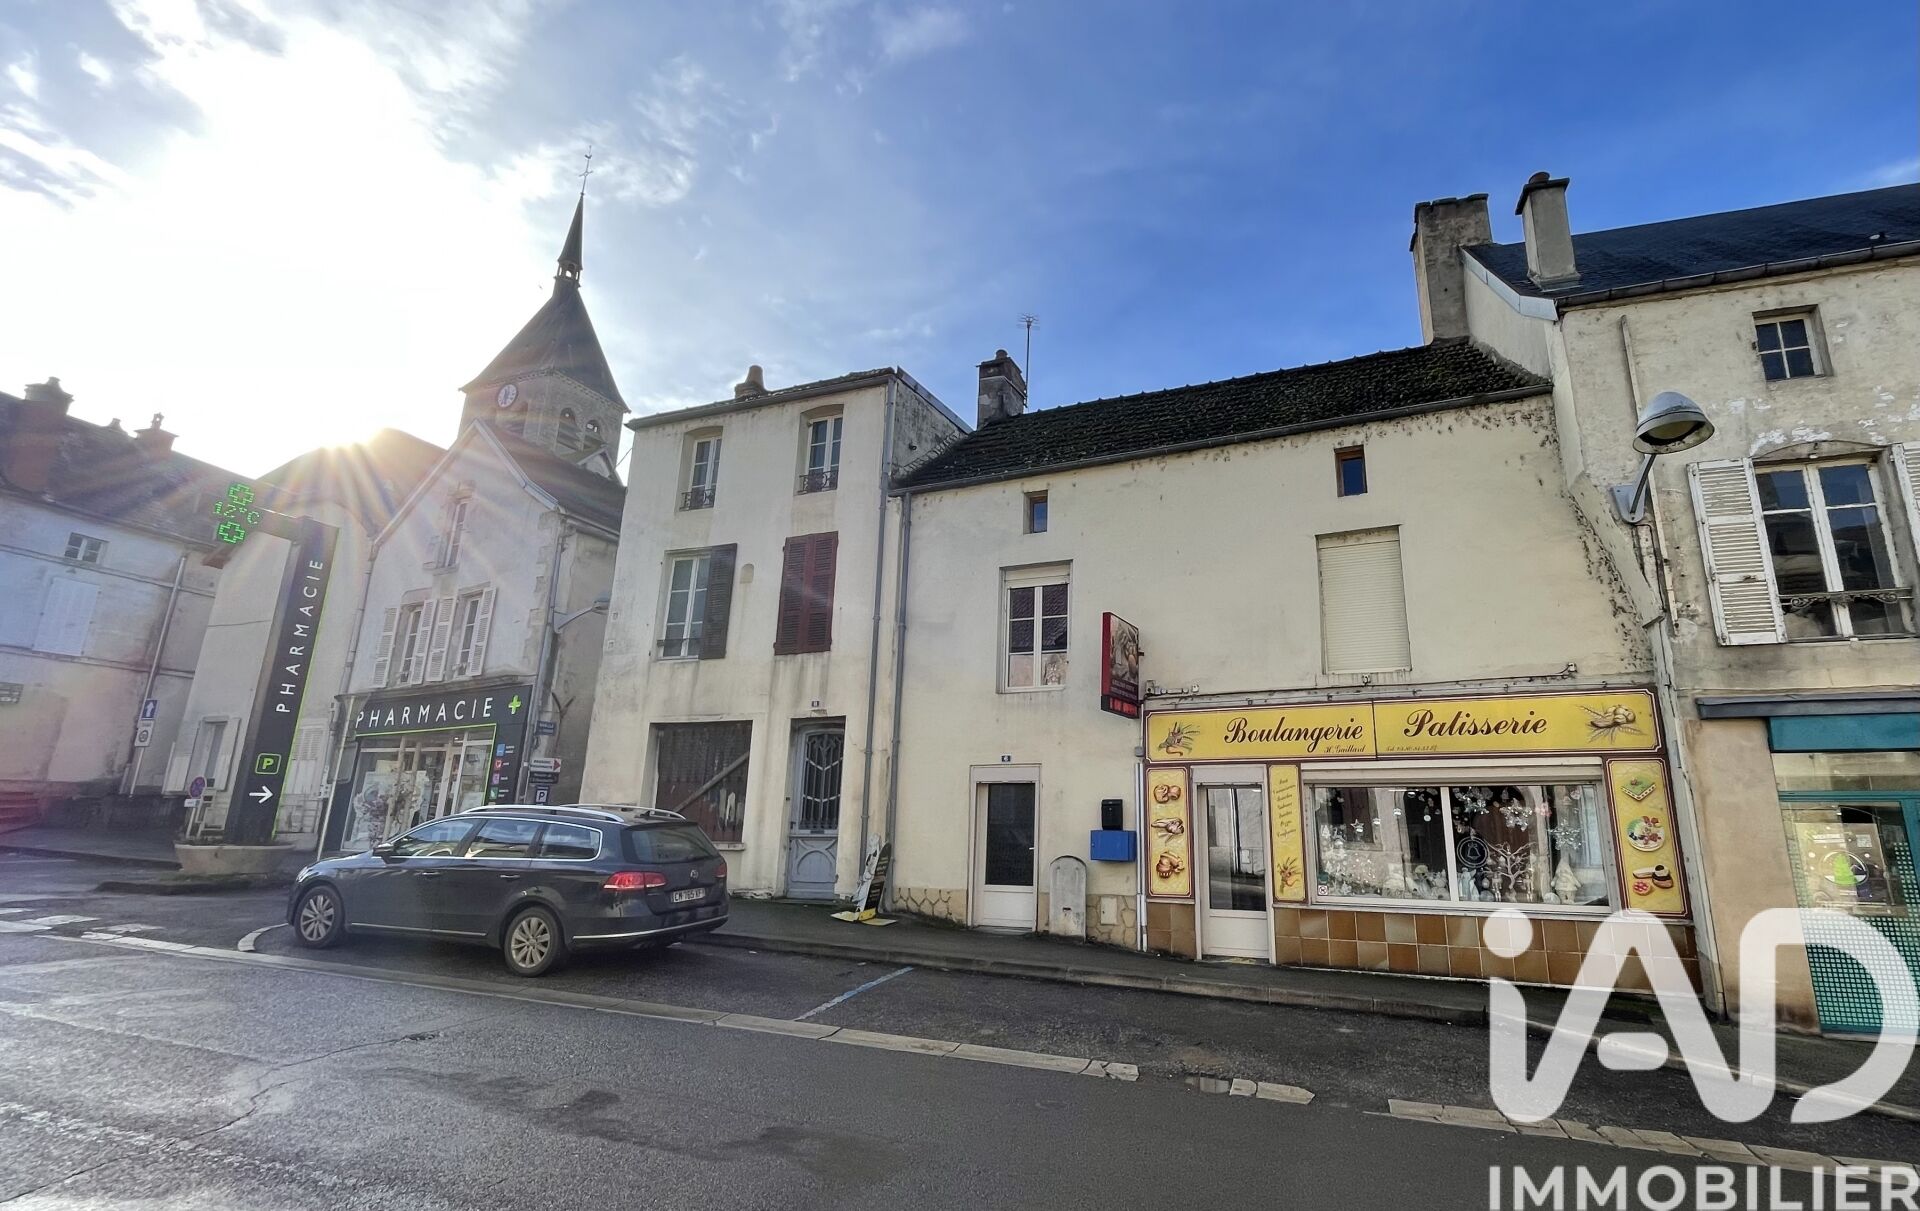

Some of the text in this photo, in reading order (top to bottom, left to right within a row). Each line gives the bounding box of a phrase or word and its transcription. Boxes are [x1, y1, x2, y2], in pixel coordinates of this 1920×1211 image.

[276, 560, 323, 712] PHARMACIE
[355, 697, 493, 728] PHARMACIE
[1404, 709, 1547, 737] Patisserie
[1223, 716, 1363, 753] Boulangerie
[262, 757, 274, 770] P
